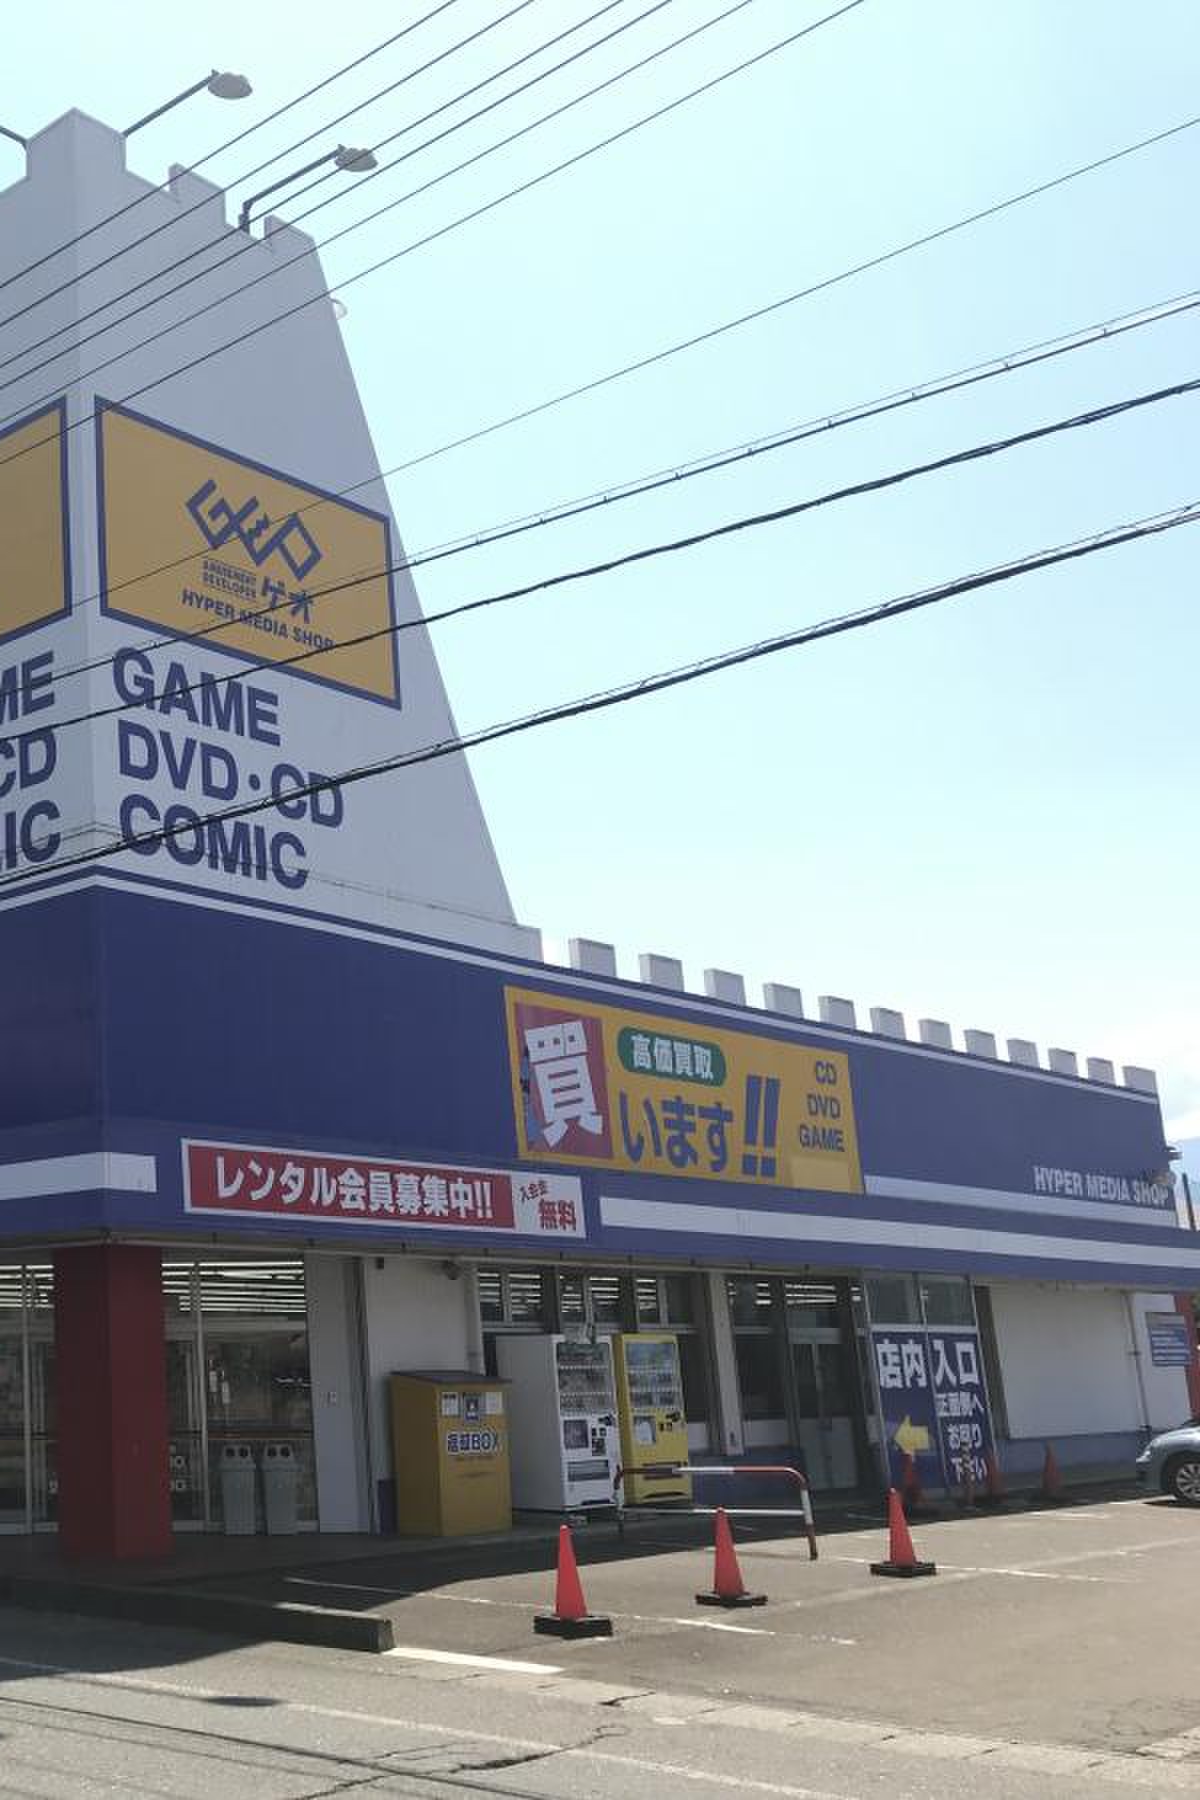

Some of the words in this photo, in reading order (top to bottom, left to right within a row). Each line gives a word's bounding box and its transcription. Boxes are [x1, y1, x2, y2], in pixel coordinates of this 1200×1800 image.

[186, 479, 322, 582] GEO
[182, 588, 235, 620] HYPER
[239, 609, 289, 639] MEDIA
[293, 626, 334, 650] SHOP
[261, 576, 314, 625] ゲオ
[113, 647, 280, 746] GAME
[119, 794, 308, 889] COMIC
[631, 1034, 714, 1080] 高価買取
[815, 1060, 837, 1085] CD
[807, 1092, 841, 1119] DVD
[799, 1124, 845, 1153] GAME
[1033, 1166, 1083, 1196] HYPER
[1086, 1174, 1130, 1200] MEDIA
[1133, 1179, 1169, 1206] SHOP
